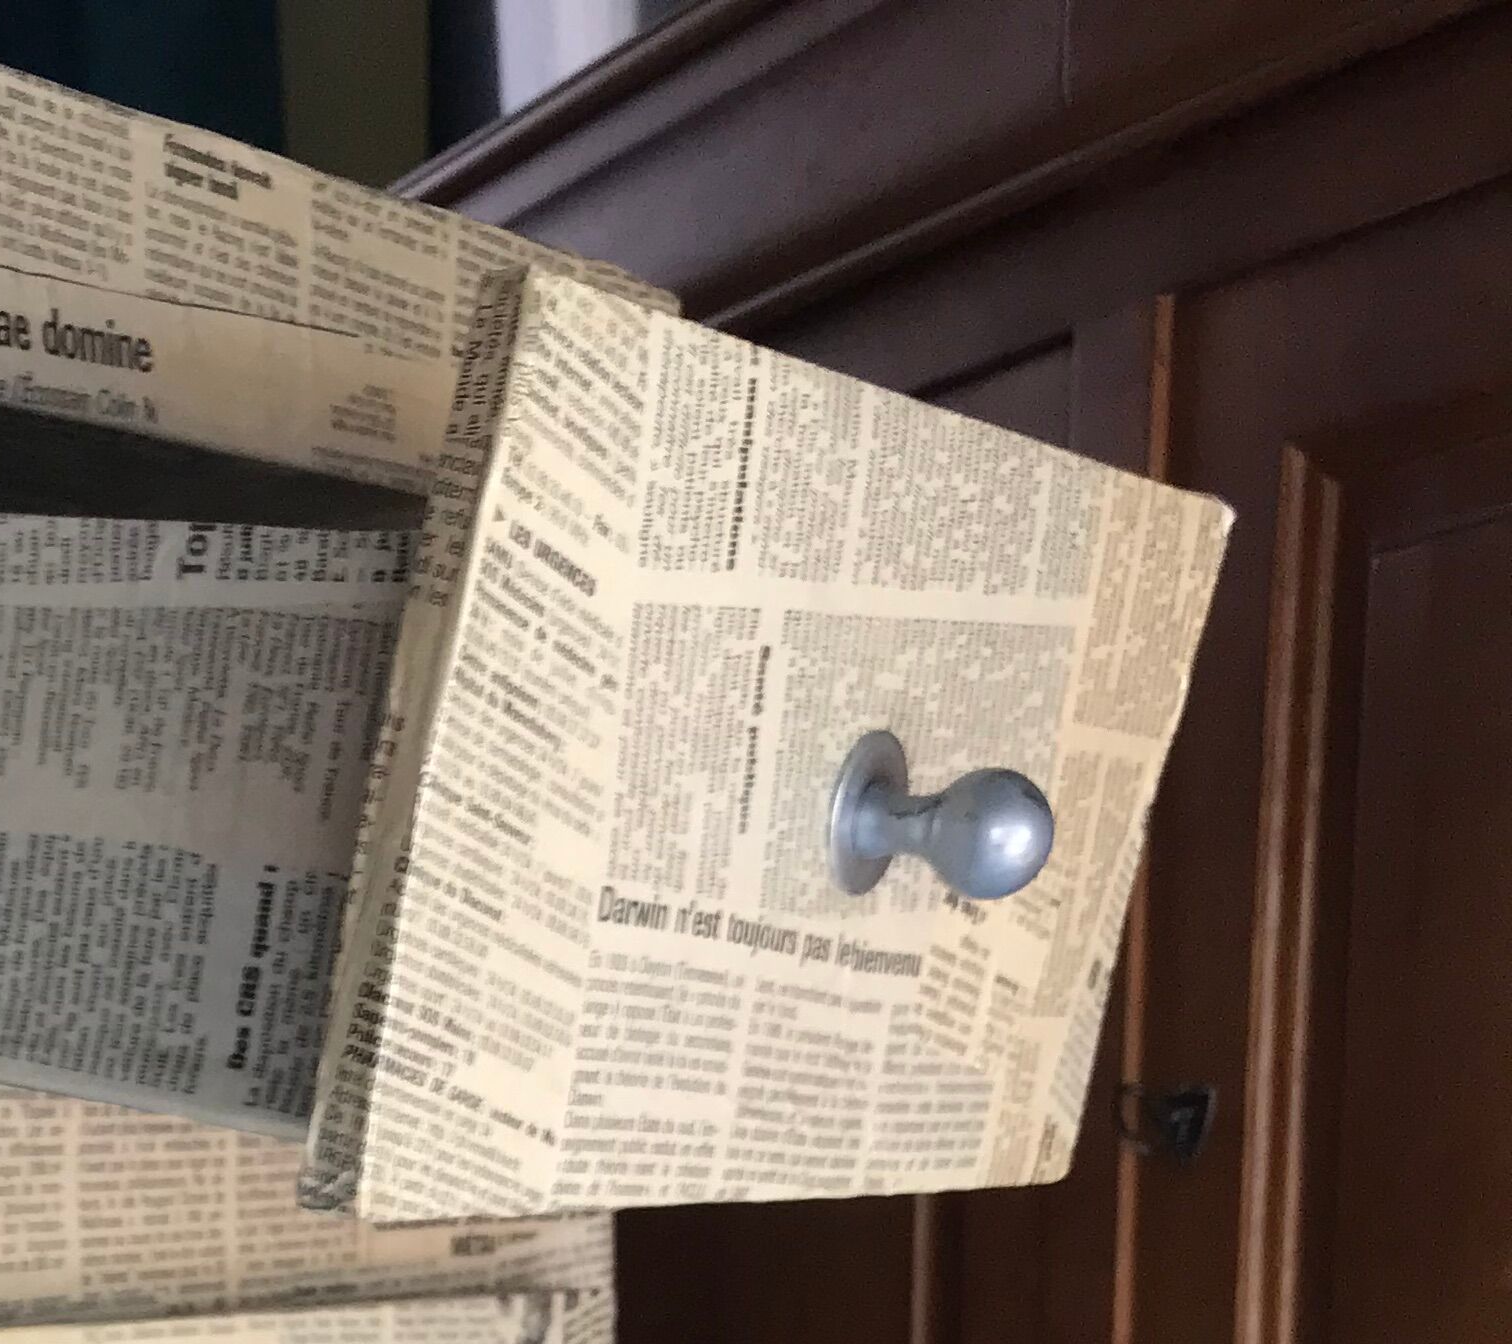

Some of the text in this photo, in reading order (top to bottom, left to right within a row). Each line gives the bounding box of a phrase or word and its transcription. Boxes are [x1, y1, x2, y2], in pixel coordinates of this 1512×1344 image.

[42, 308, 154, 373] domine
[596, 885, 669, 931] Darwin
[674, 899, 724, 940] n'est
[726, 911, 798, 958] toujours
[799, 931, 831, 967] pas
